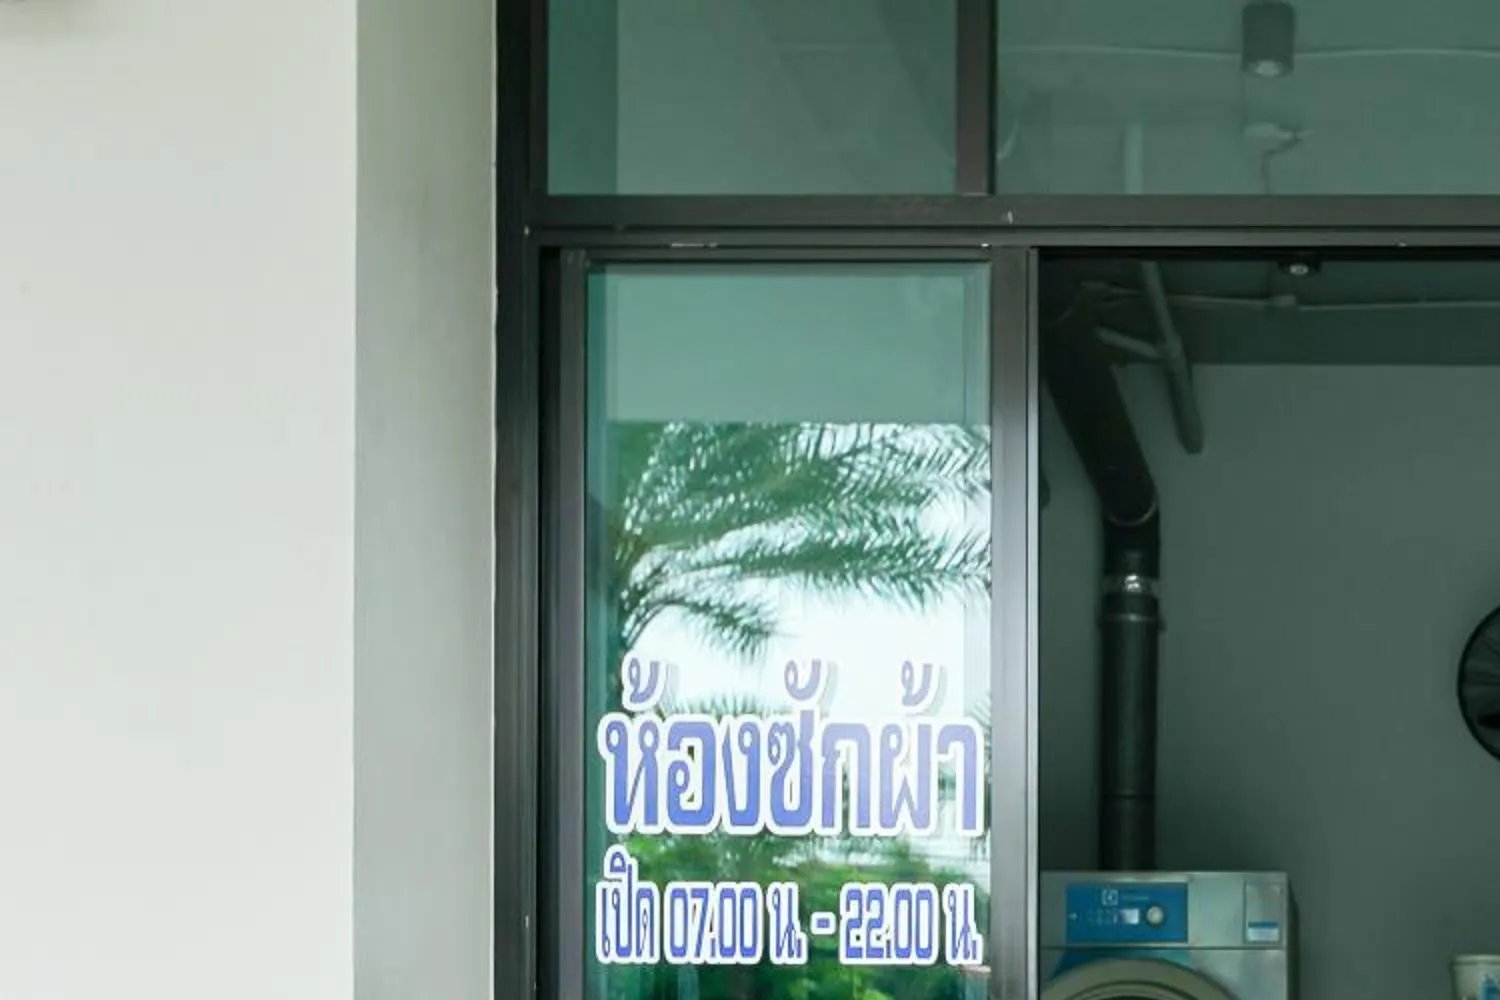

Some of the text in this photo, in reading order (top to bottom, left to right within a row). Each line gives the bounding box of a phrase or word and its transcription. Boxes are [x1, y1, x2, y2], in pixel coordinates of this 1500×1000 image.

[605, 657, 978, 830] ห้องซักผ้า
[601, 851, 655, 959] เปิด
[669, 887, 758, 959] 07.00
[771, 887, 803, 959] น.
[845, 888, 933, 959] 22.00
[947, 888, 978, 959] น.
